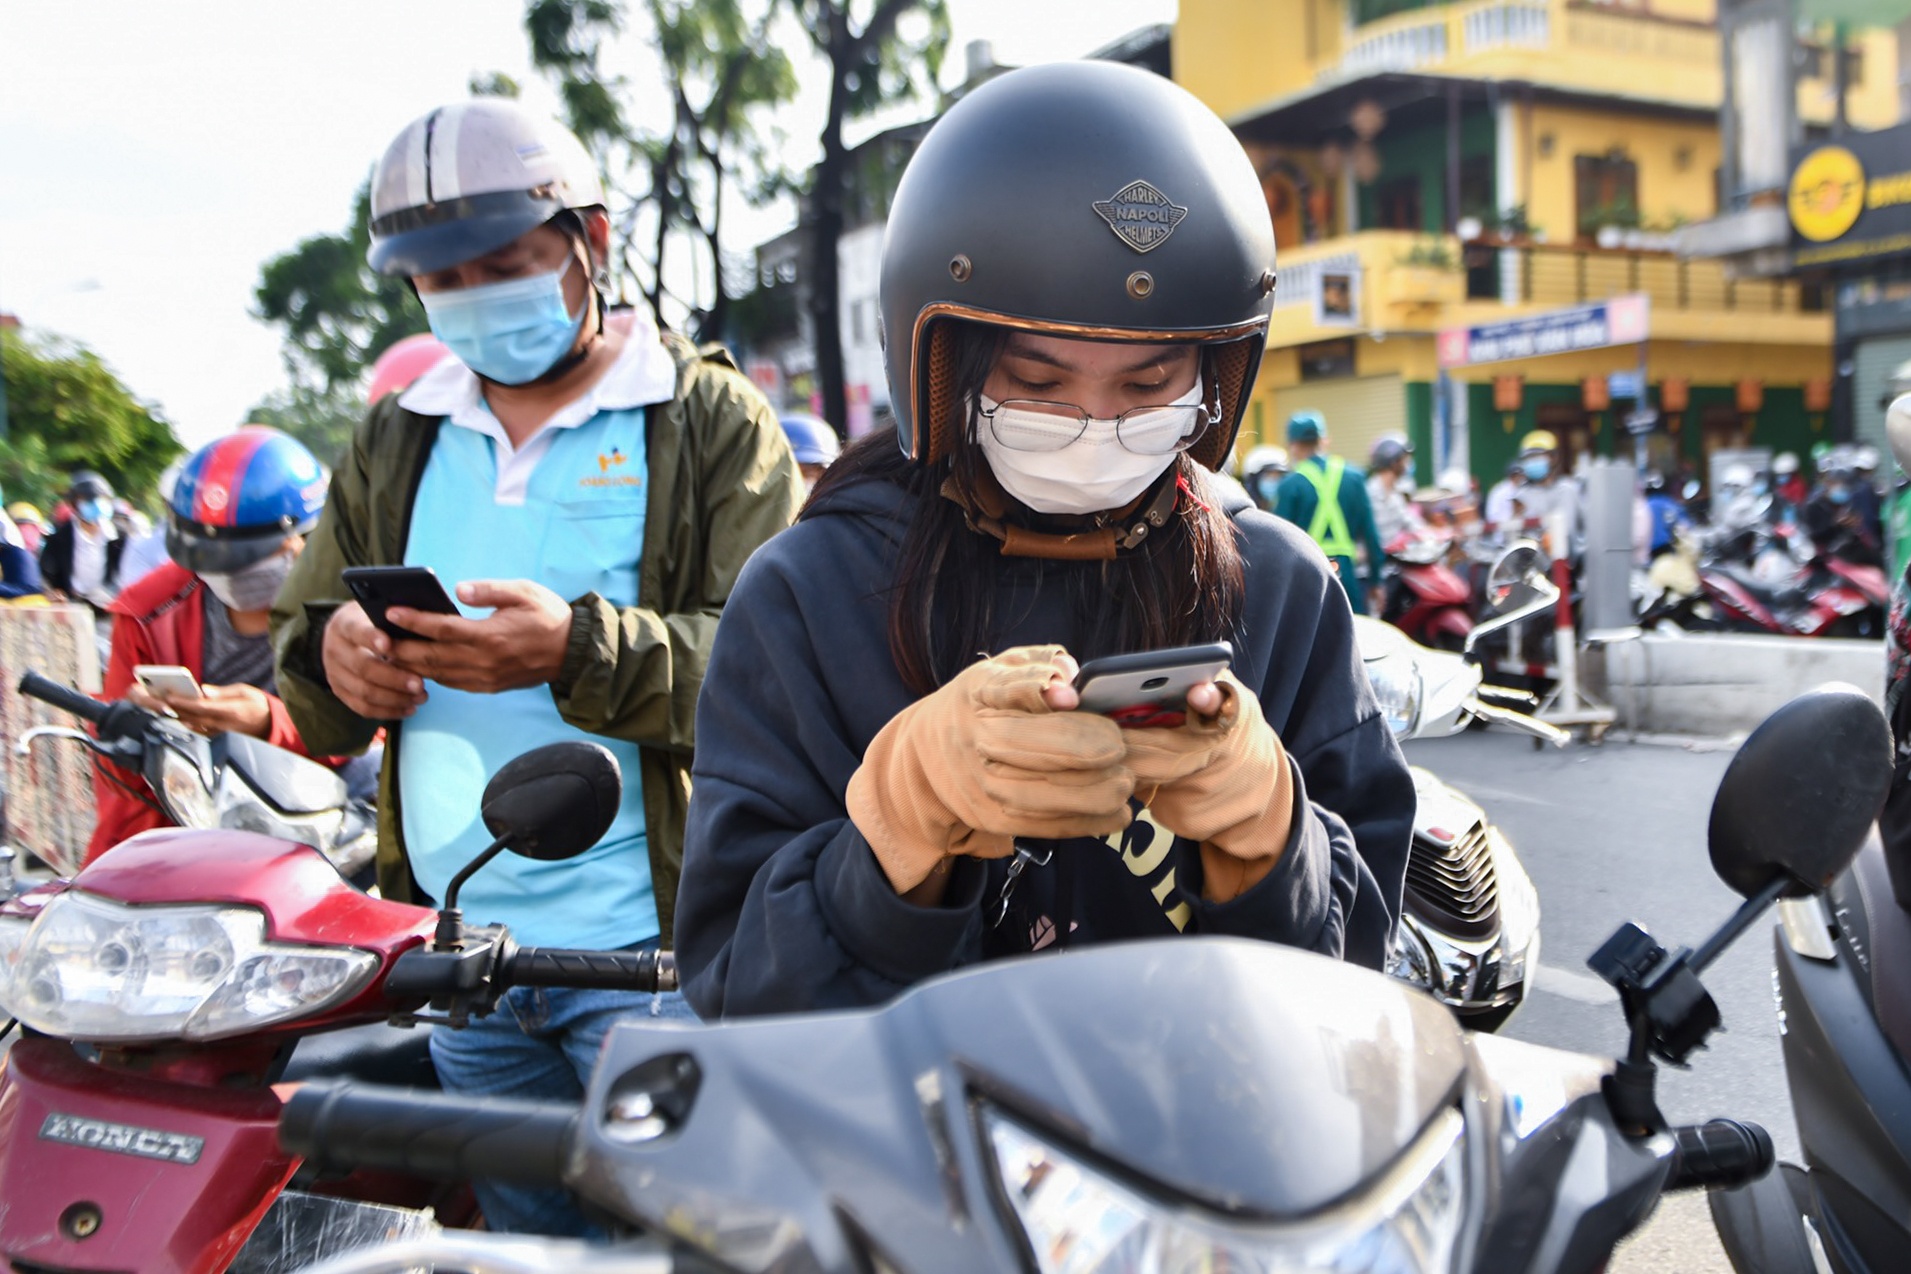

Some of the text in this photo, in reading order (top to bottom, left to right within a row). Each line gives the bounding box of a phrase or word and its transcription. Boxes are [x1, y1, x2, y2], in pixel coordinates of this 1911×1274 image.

[1124, 187, 1160, 204] HARLEY
[1116, 207, 1169, 223] NAPOLI
[1125, 225, 1162, 244] HELMETS
